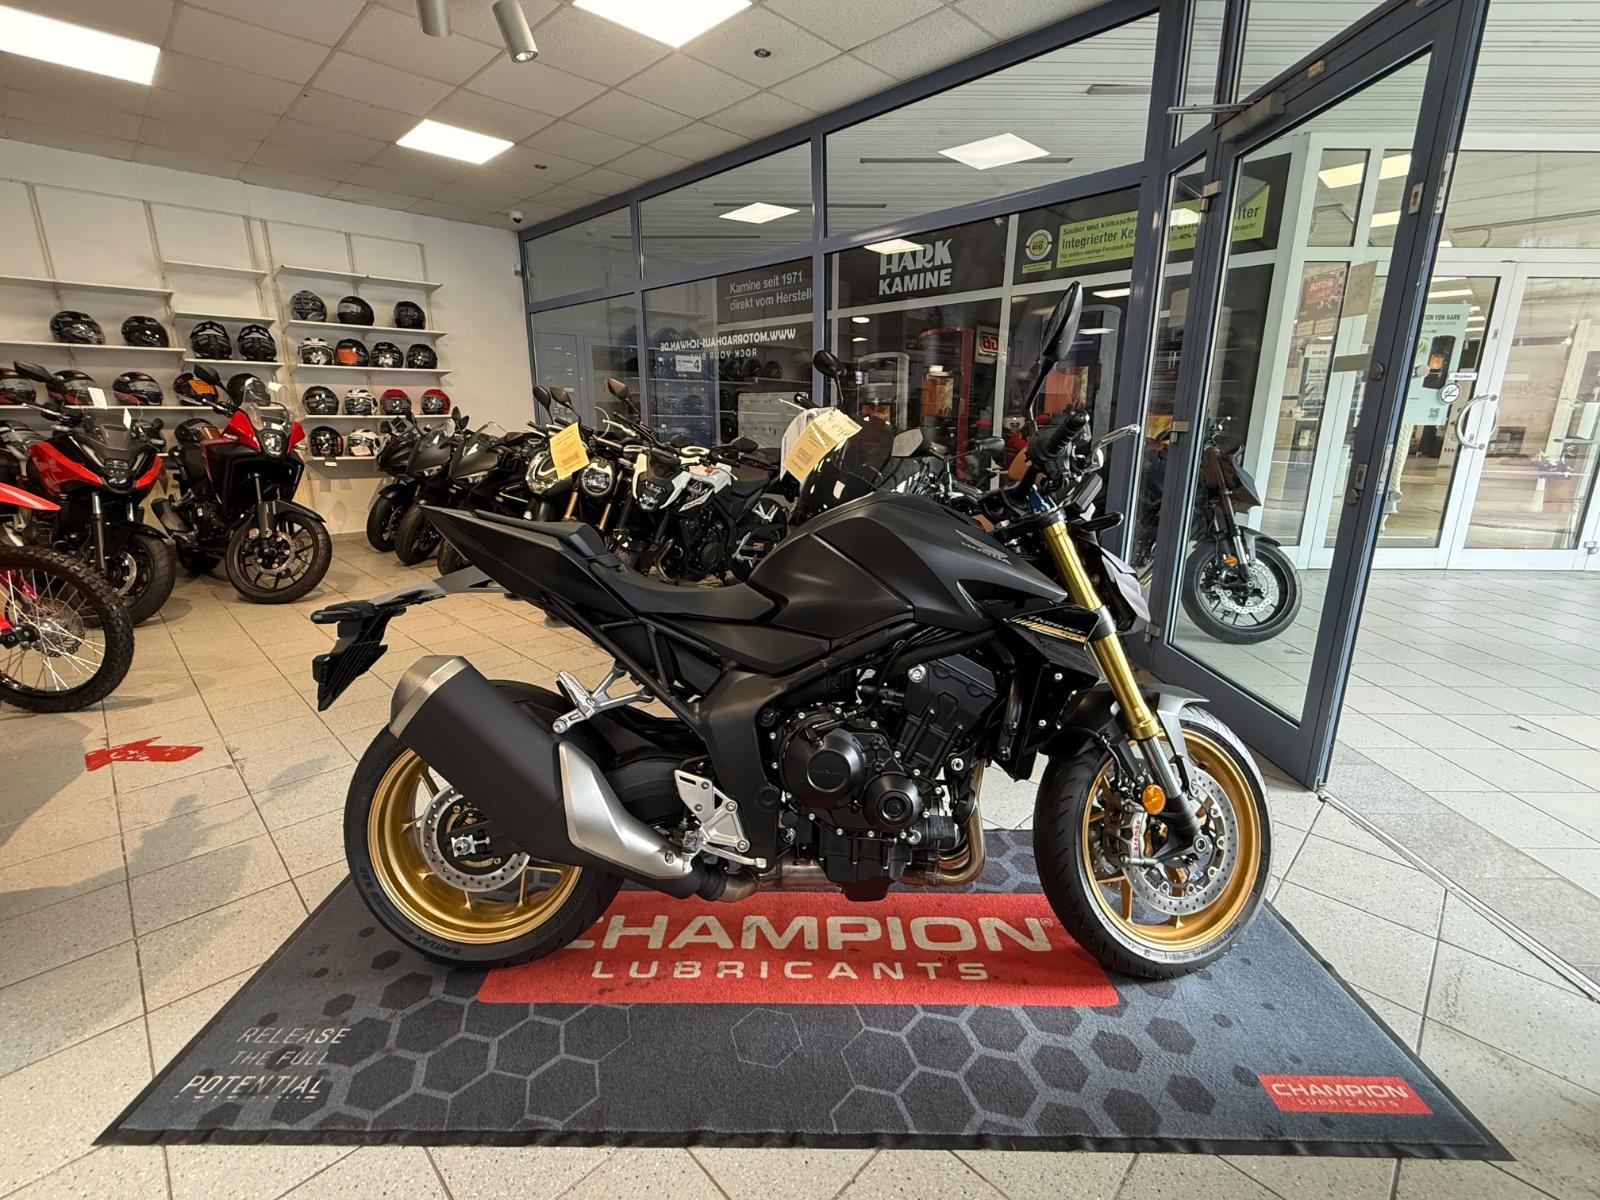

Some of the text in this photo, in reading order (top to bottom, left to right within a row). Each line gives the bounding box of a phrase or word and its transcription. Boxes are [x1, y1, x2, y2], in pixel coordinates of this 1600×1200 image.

[1087, 223, 1100, 231] und
[1062, 227, 1137, 250] Integrierter Ke
[880, 239, 952, 275] HARK
[729, 270, 802, 294] Kamine seit 1971
[879, 268, 952, 295] KAMINE
[730, 287, 813, 310] direkt vom Herstell
[591, 961, 989, 980] LUBRICANTS
[237, 1028, 352, 1044] RELEASE
[230, 1051, 330, 1066] THE FULL
[179, 1075, 325, 1094] POTENTIAL
[1271, 1083, 1409, 1099] CHAMPION
[1298, 1098, 1399, 1107] LUBRICANTS
